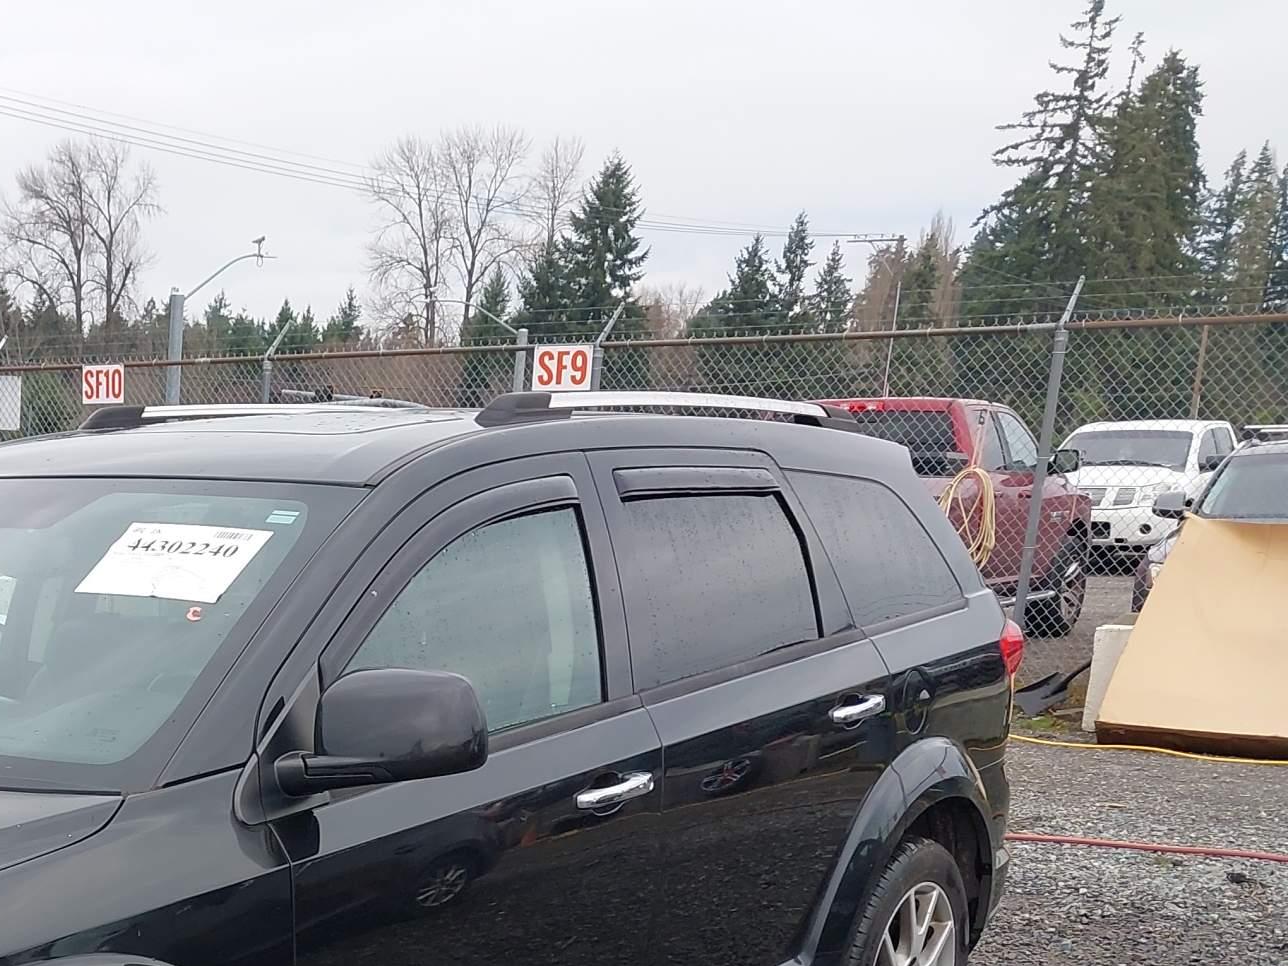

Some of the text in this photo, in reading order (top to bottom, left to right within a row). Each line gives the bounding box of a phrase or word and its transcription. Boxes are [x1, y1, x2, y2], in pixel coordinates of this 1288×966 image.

[537, 350, 588, 386] SF9
[84, 369, 122, 399] SF10
[127, 537, 239, 558] 44302240
